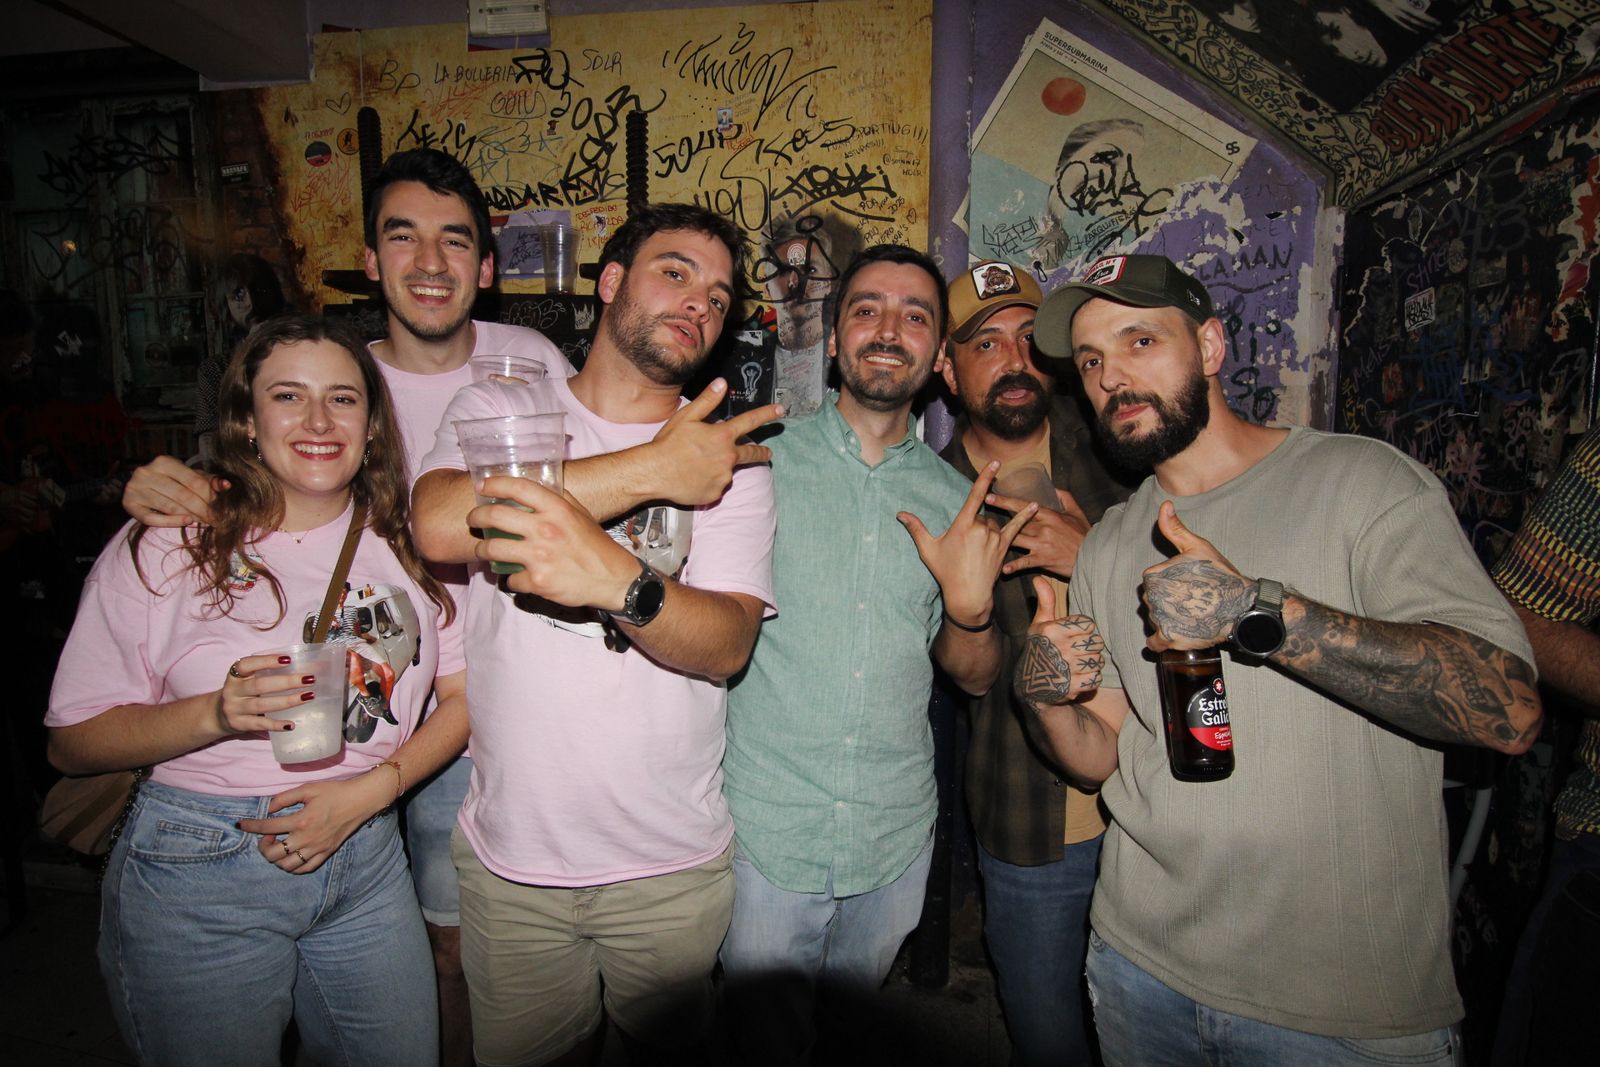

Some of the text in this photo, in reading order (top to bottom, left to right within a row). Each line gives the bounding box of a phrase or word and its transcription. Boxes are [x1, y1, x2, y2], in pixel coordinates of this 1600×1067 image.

[1044, 31, 1108, 72] SUPERSUBMARINA
[1370, 8, 1561, 153] BUENA SUERTE
